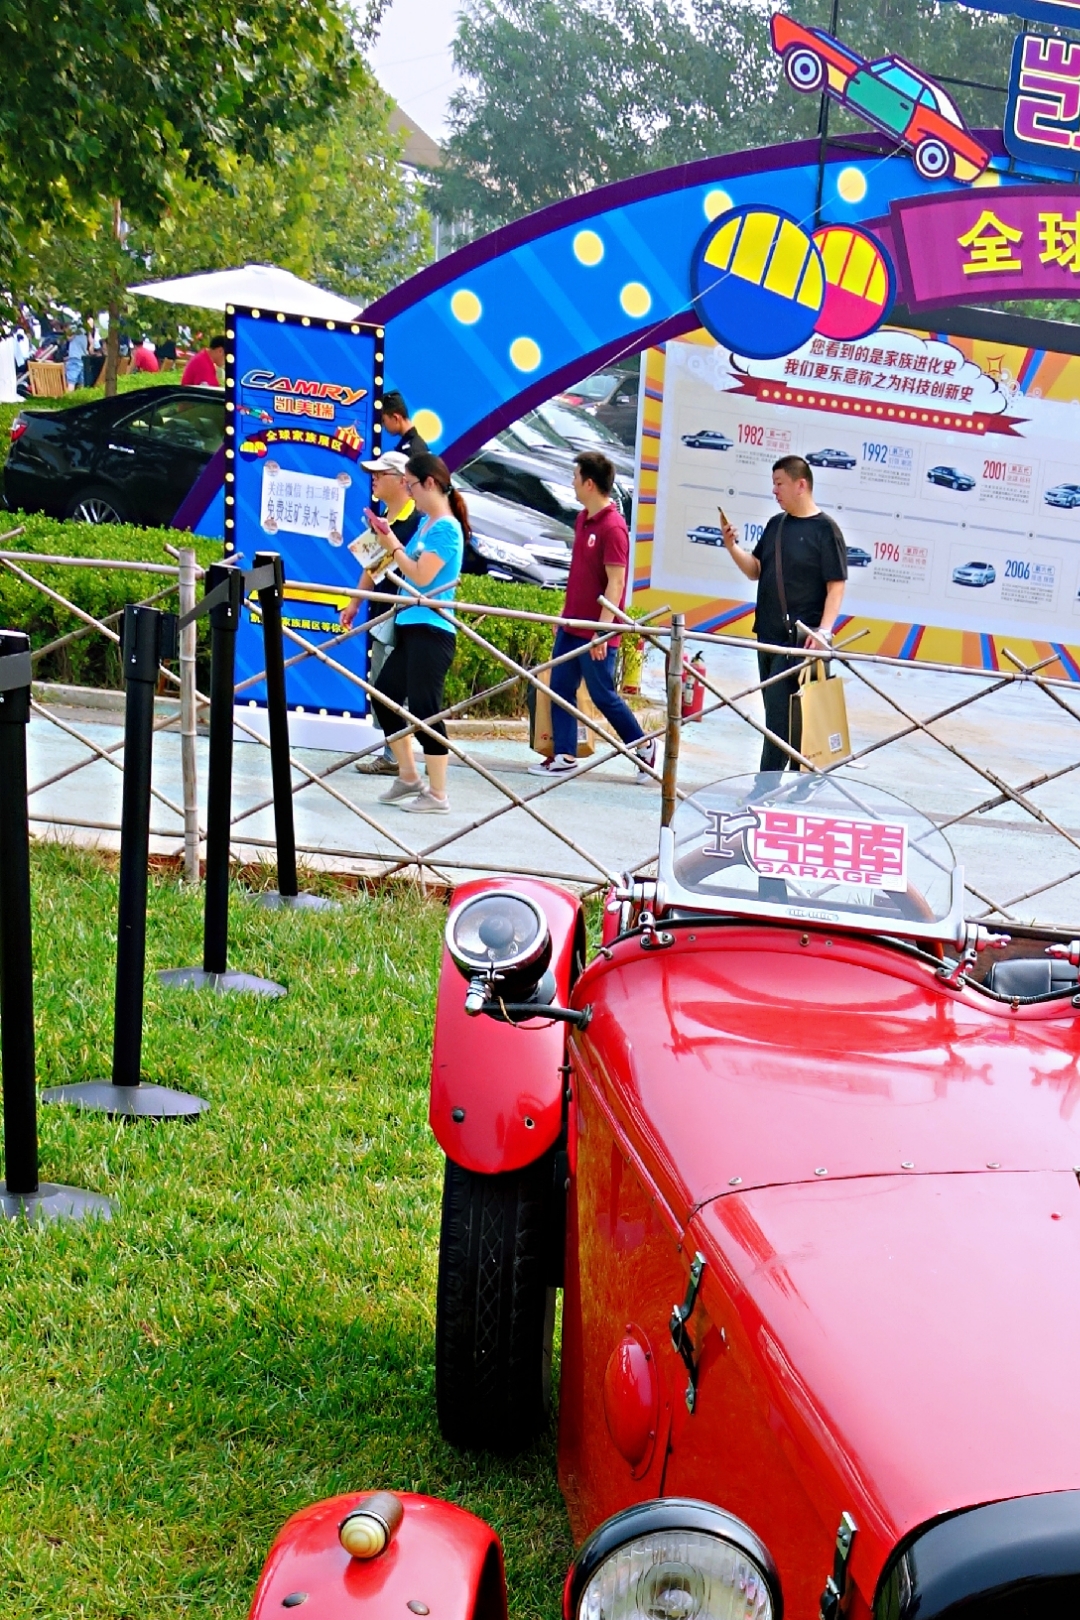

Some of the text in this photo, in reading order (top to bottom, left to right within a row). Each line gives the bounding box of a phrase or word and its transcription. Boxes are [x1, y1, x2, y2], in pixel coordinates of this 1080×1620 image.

[809, 338, 957, 376] 您看到的是家族进化史
[240, 369, 368, 405] CAMRY
[784, 358, 975, 402] 我们更乐意称之为科技创新史
[275, 395, 335, 420] 凯美瑞
[266, 430, 343, 452] 全球家族展区
[737, 423, 764, 446] 1982
[861, 442, 888, 464] 1992
[982, 460, 1007, 481] 2001
[873, 542, 900, 562] 1996
[1004, 559, 1031, 580] 2006
[756, 861, 883, 885] GARAGE
